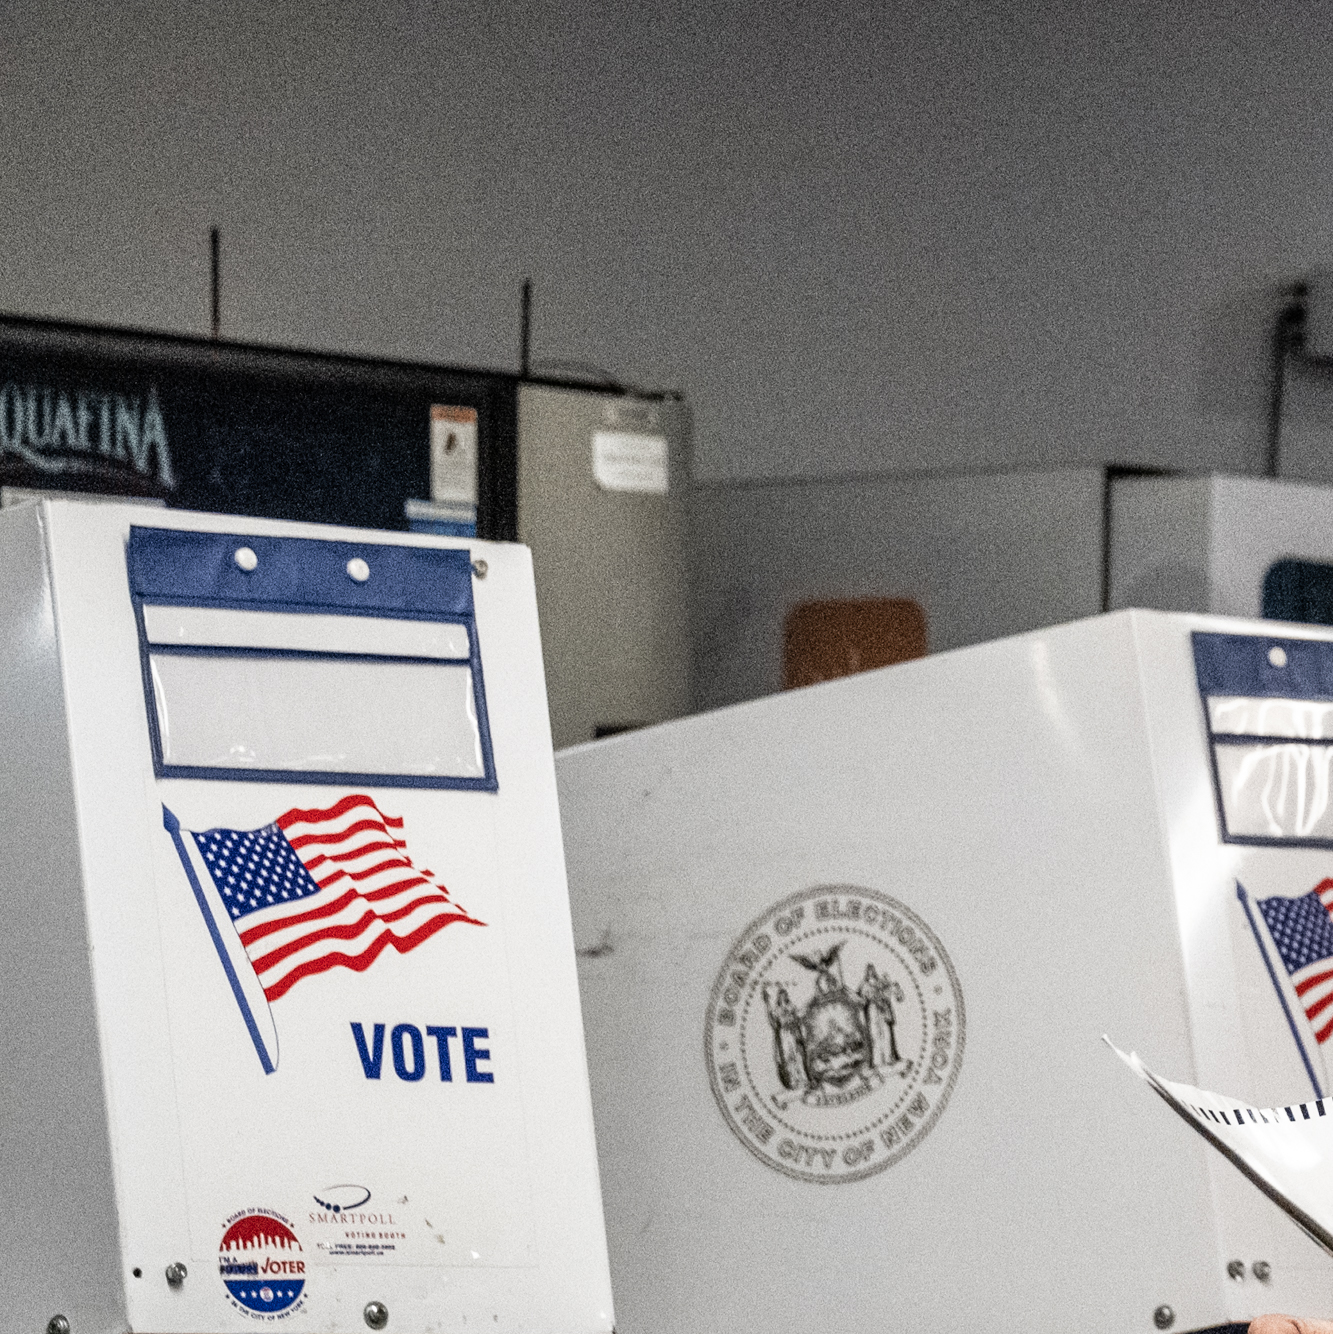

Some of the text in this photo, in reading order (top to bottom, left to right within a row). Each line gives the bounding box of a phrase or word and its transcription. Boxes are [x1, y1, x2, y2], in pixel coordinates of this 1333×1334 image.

[0, 380, 175, 490] QUAFINA
[718, 899, 938, 1027] BOARD OF ELECTIONS
[350, 1021, 495, 1084] VOTE
[718, 1062, 742, 1093] IN
[734, 1093, 775, 1144] THE
[777, 1137, 837, 1170] CITY
[842, 1139, 875, 1166] OF
[879, 1090, 930, 1149] NEW
[922, 1007, 953, 1086] YORK
[309, 1213, 396, 1224] SMARTPOLL
[345, 1231, 376, 1239] VOTING
